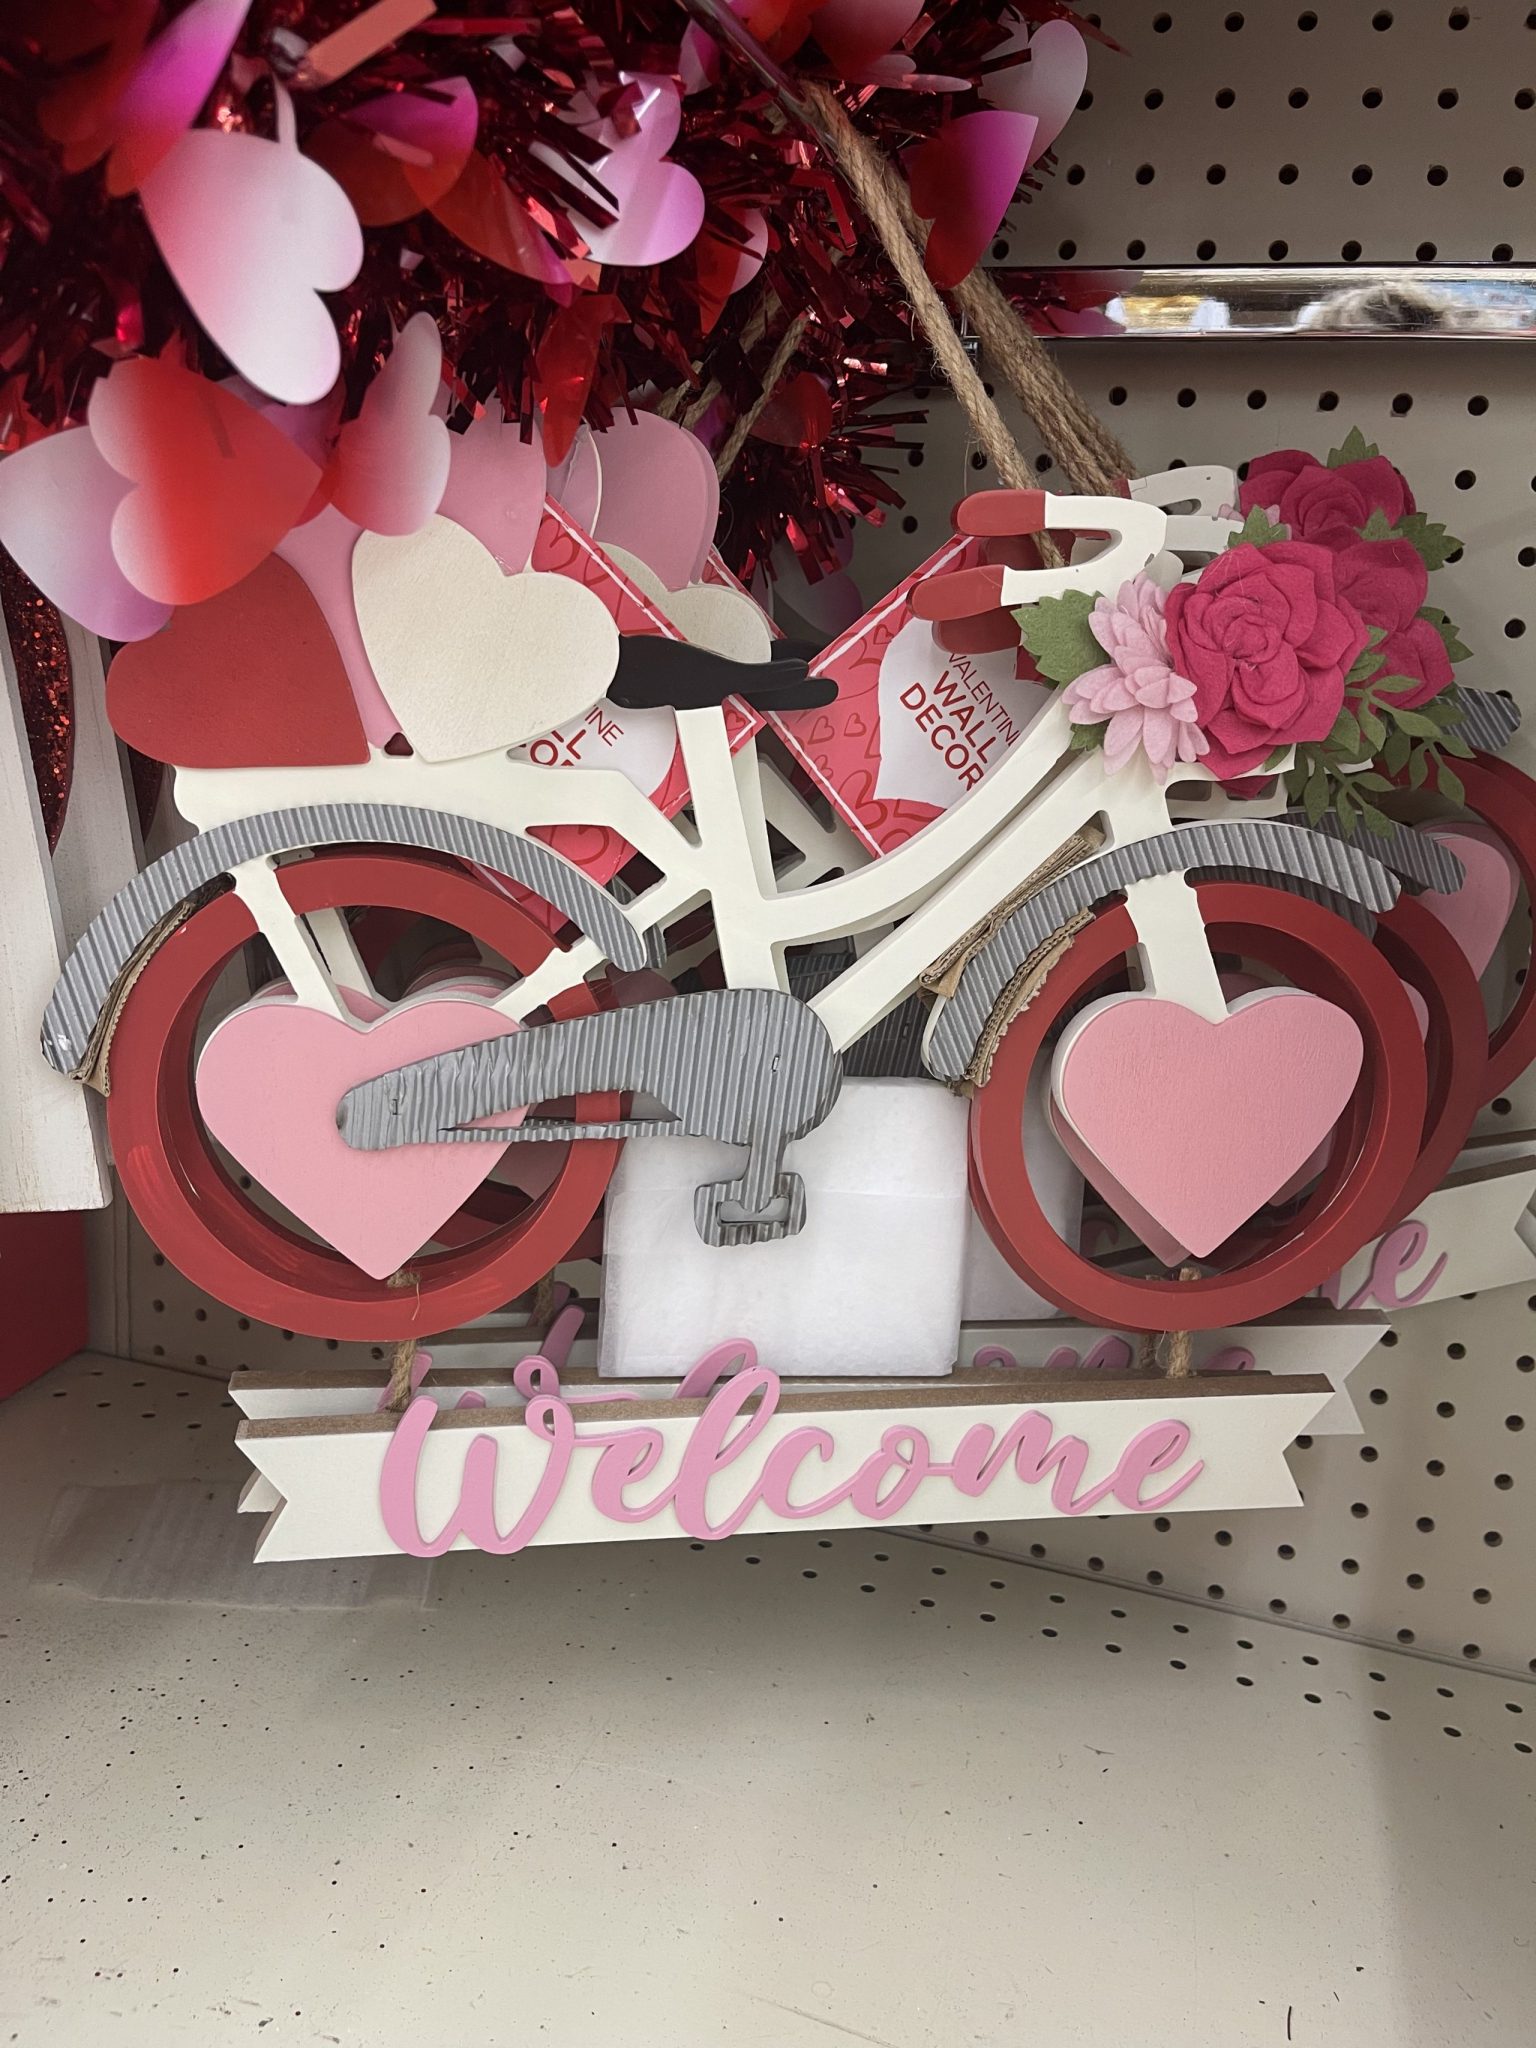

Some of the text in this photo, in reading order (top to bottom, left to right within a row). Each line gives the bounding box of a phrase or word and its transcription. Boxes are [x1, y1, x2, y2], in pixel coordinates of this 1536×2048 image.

[900, 682, 984, 791] DECOR
[933, 670, 996, 763] WALL
[379, 1366, 1205, 1558] Welcome
